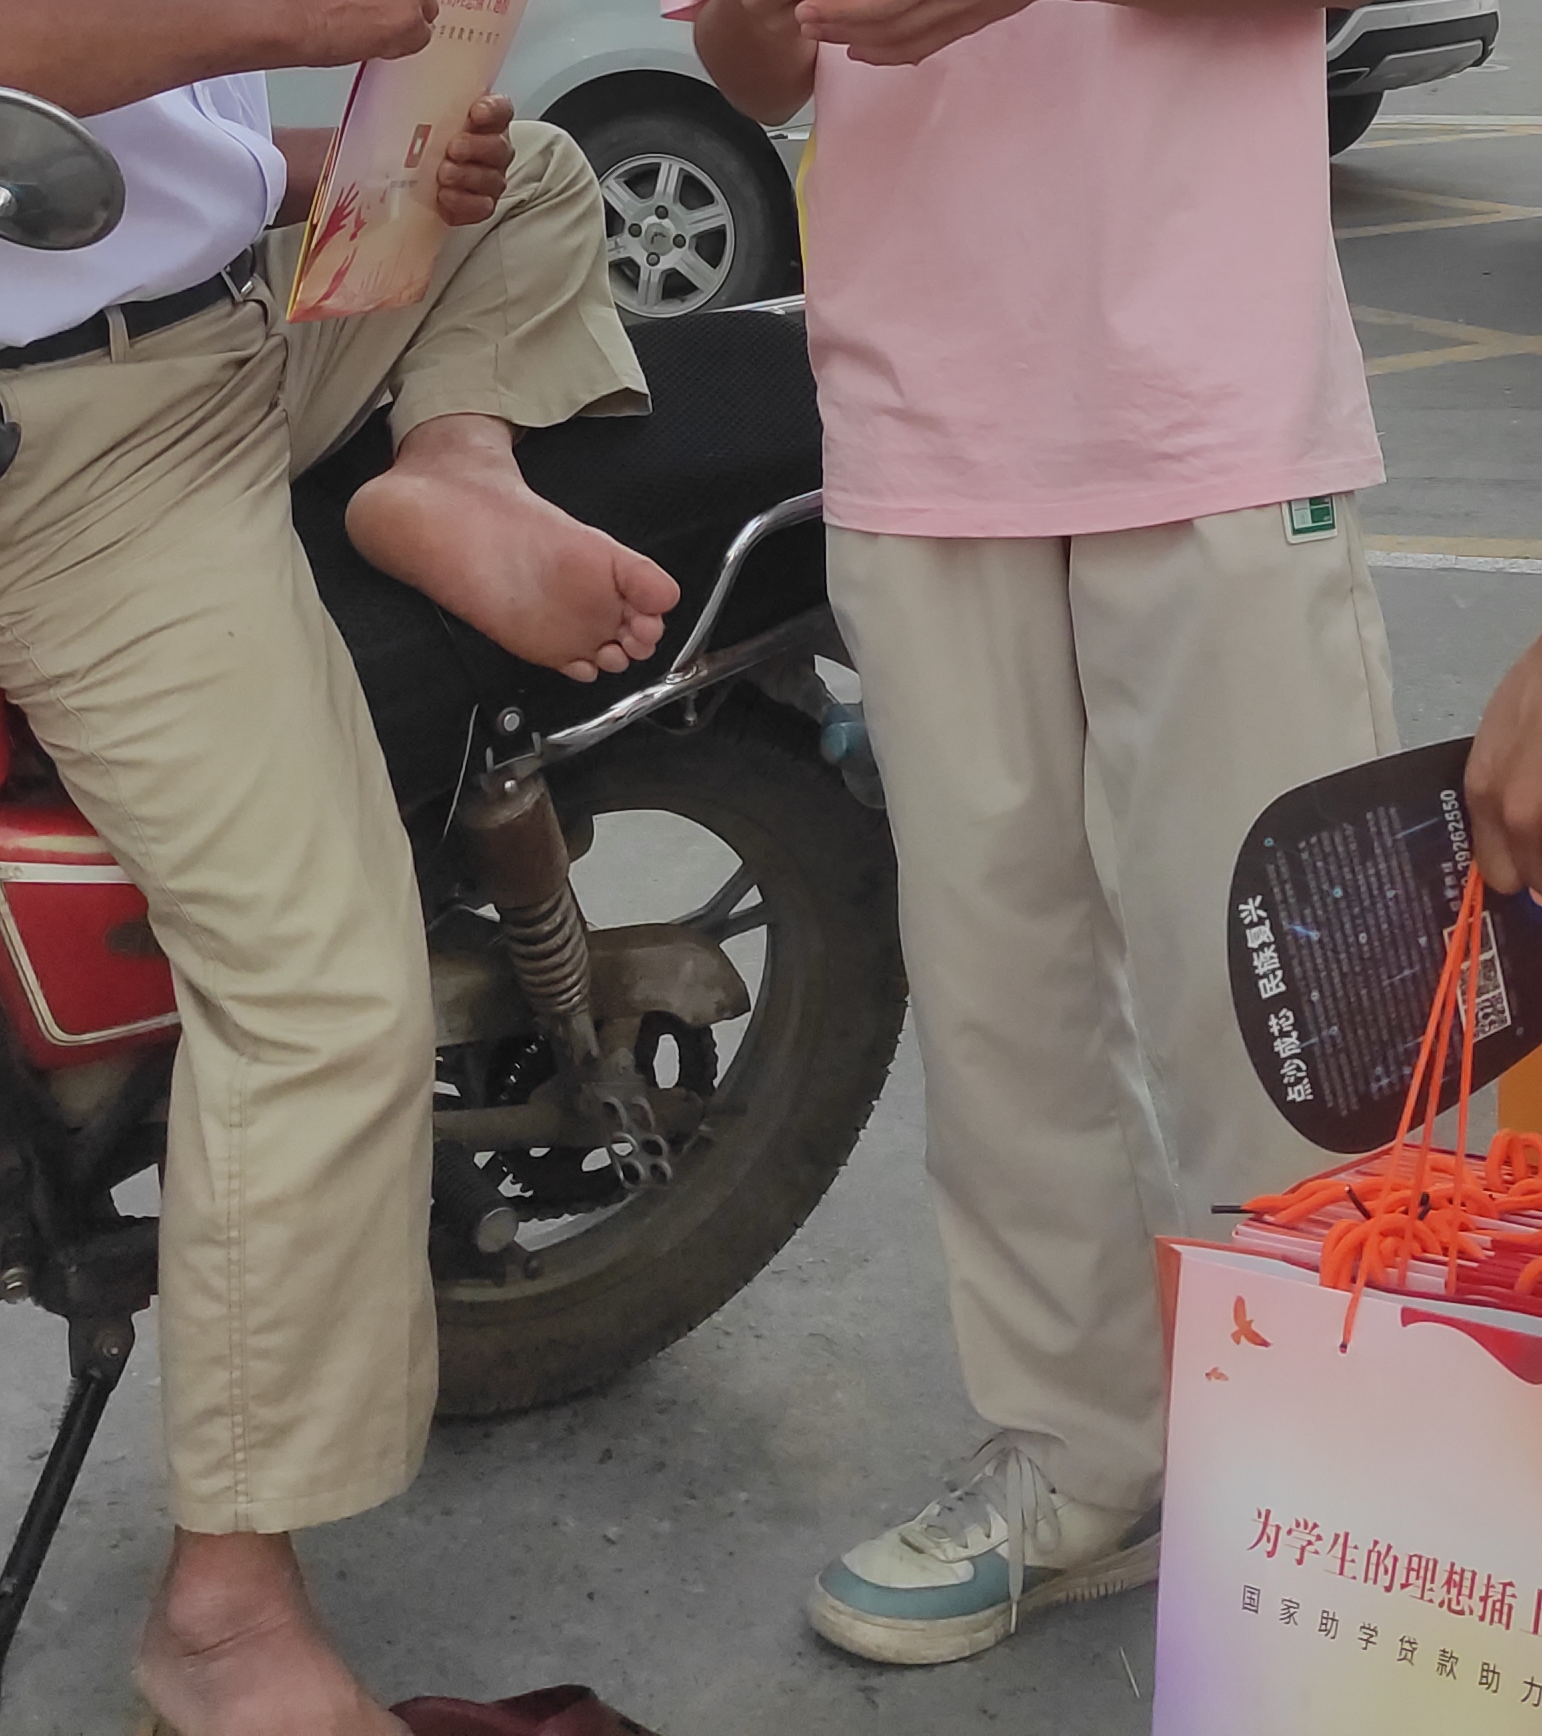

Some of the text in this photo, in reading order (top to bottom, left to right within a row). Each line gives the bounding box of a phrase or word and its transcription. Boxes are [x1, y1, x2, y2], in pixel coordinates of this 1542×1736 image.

[1239, 895, 1314, 1102] 点沙成芯 民族复兴
